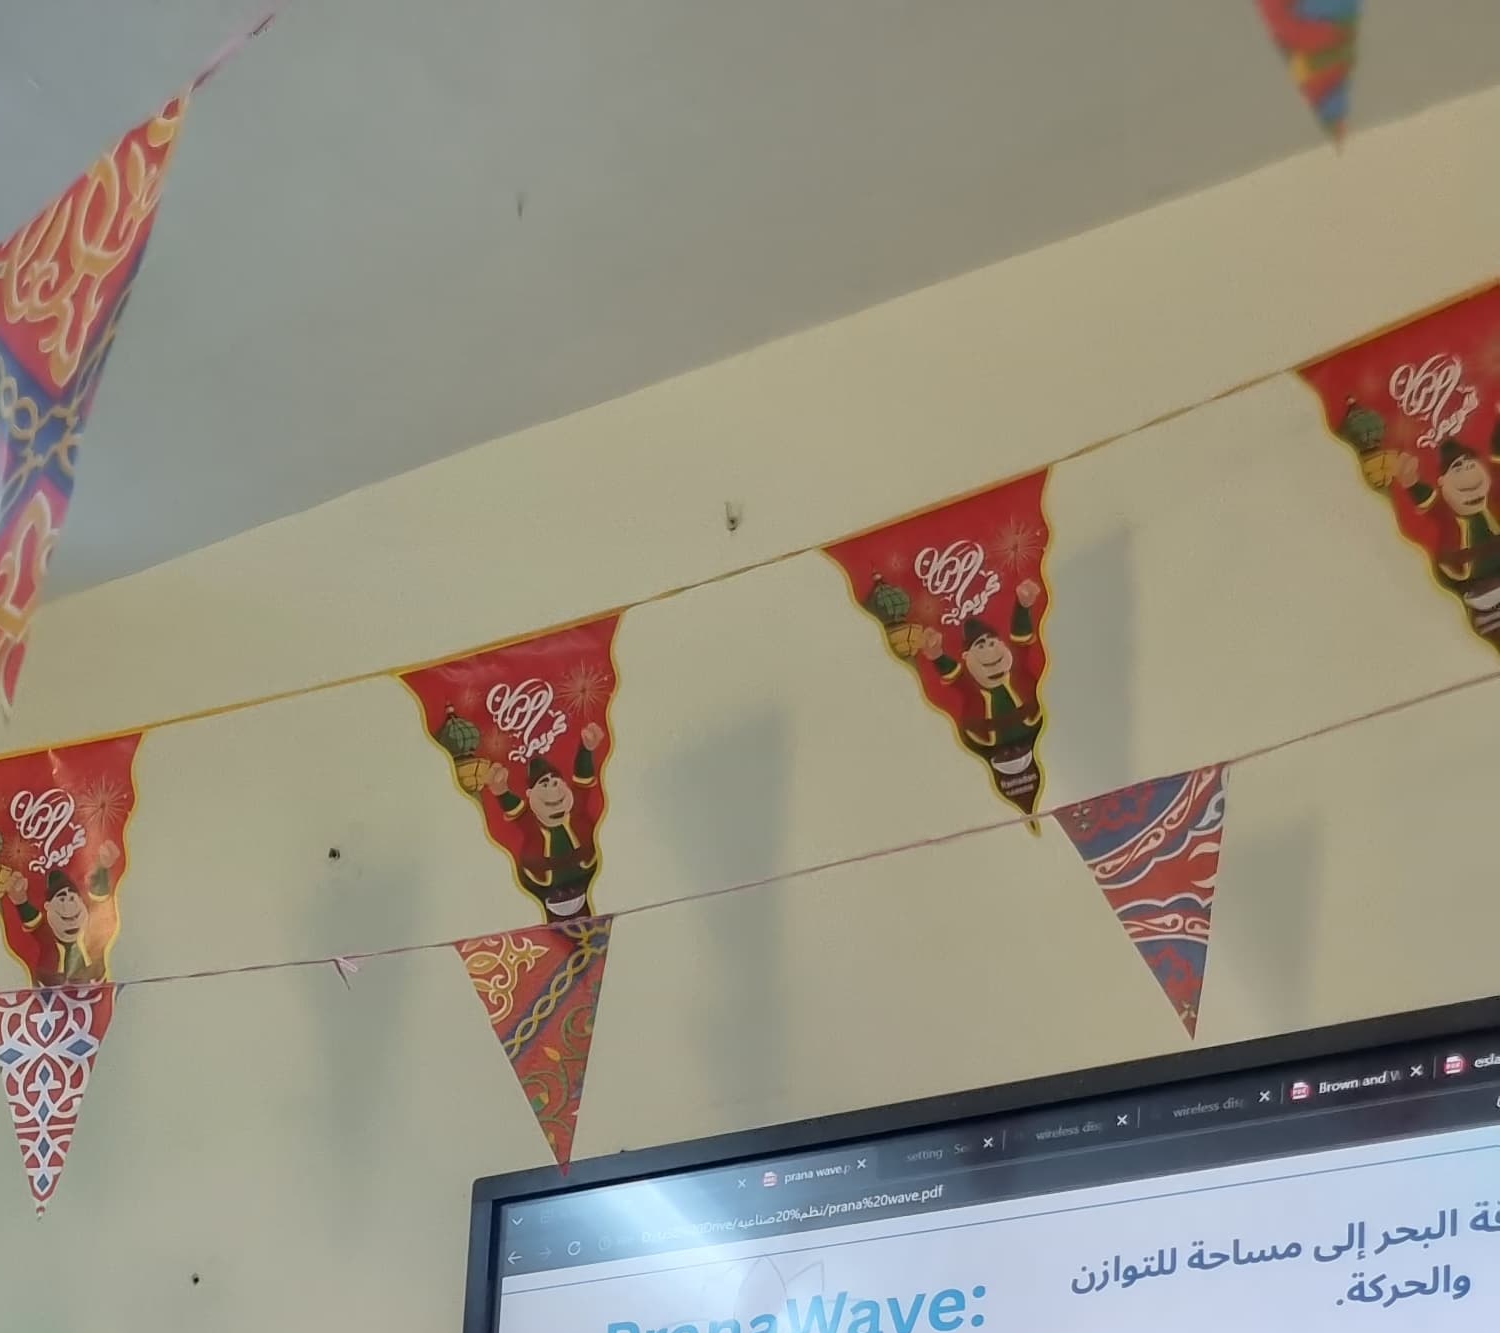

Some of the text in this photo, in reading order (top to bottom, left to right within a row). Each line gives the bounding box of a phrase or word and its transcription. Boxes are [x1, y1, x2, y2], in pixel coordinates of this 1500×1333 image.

[1319, 1076, 1359, 1095] Brown
[1363, 1070, 1387, 1087] and
[1173, 1100, 1220, 1118] wireless
[1036, 1123, 1080, 1140] wireless
[907, 1148, 943, 1162] setting
[784, 1168, 813, 1184] prana
[1313, 1221, 1365, 1262] إلى
[1374, 1208, 1457, 1255] البحر
[1187, 1238, 1302, 1270] مساحة
[1071, 1247, 1177, 1294] للتوازن
[1336, 1264, 1471, 1308] والحركة.
